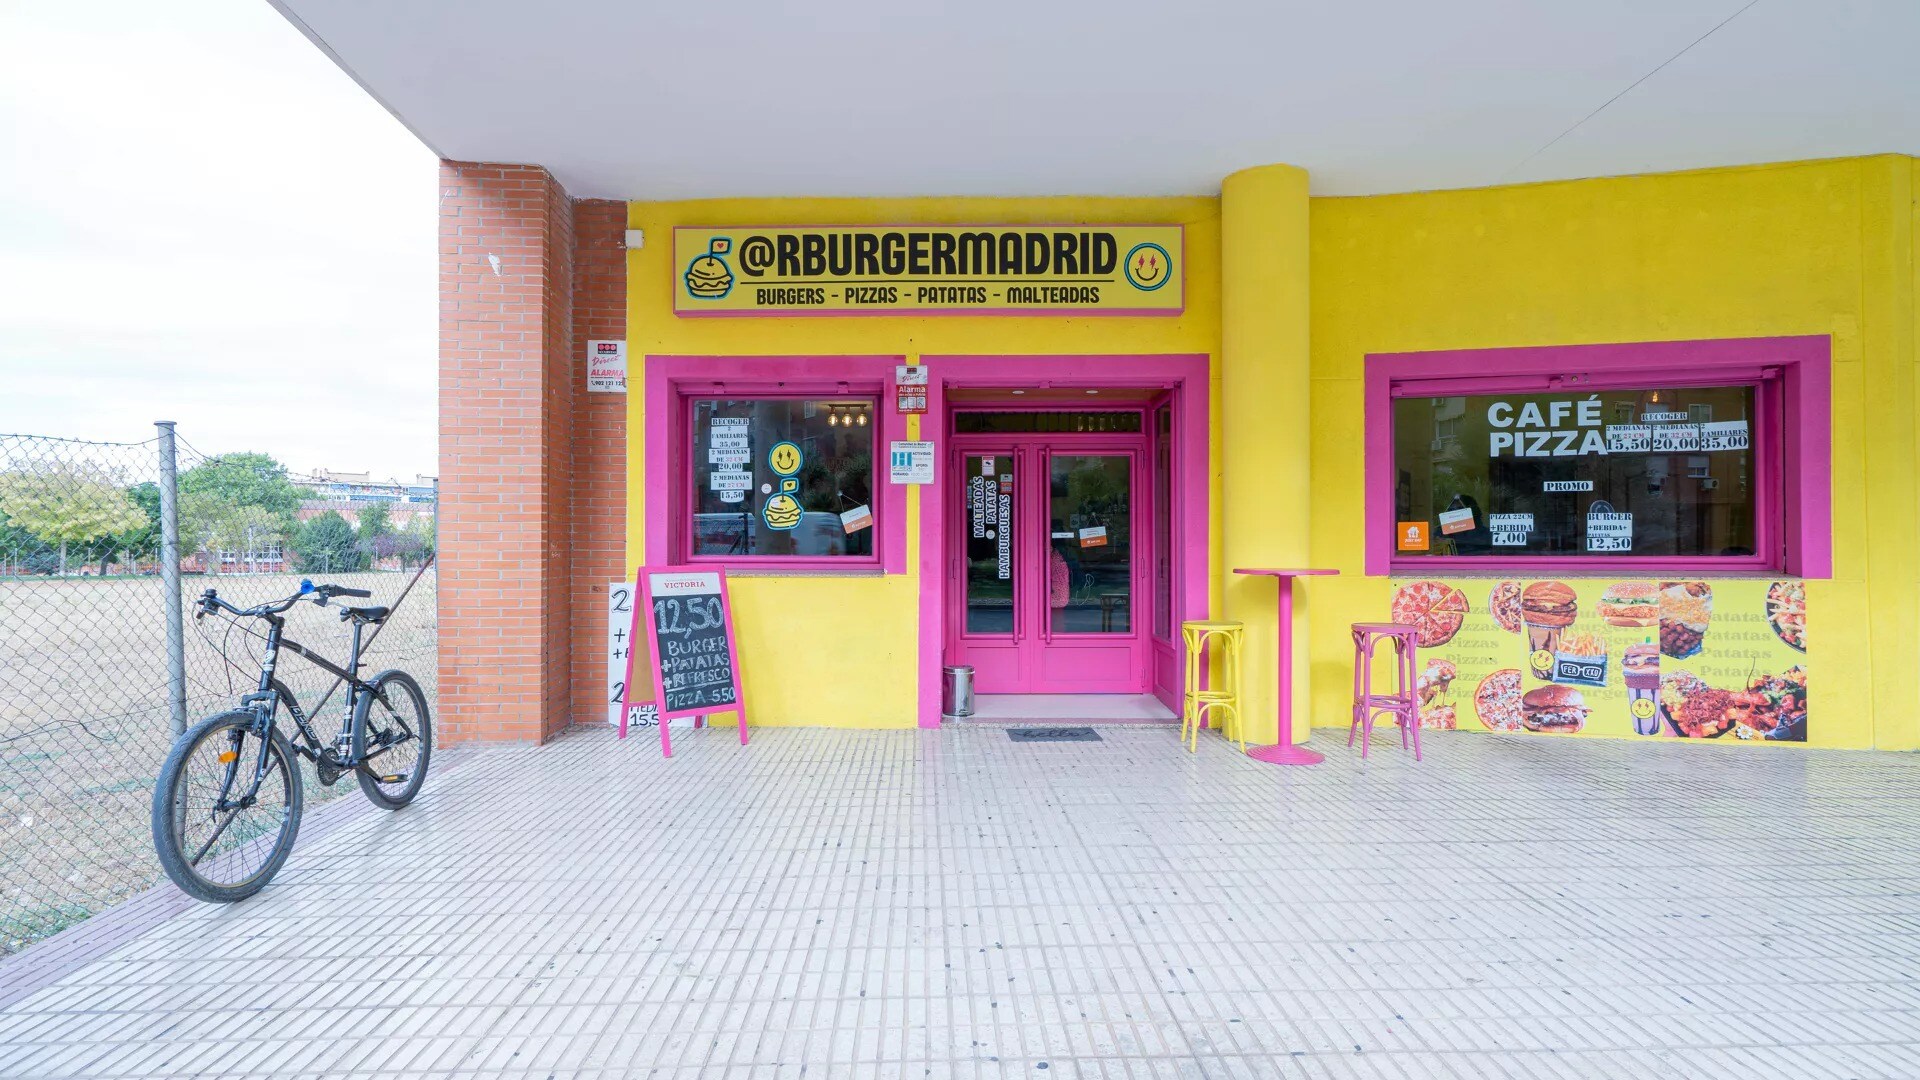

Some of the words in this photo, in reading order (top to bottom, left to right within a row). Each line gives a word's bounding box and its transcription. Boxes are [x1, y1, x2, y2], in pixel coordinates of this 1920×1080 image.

[739, 232, 1118, 276] @RBURGERMADRID
[756, 287, 825, 305] BURGERS
[845, 286, 898, 304] PIZZAS
[917, 286, 987, 304] PATATAS
[1007, 286, 1100, 304] MALTEADAS
[591, 369, 625, 377] ALARMA
[1487, 394, 1602, 429] CAFÉ
[1642, 413, 1687, 421] RECOGER
[712, 418, 749, 426] RECOGER
[1660, 423, 1699, 431] MEDIANAS
[1701, 429, 1748, 437] FAMILIARES
[719, 441, 741, 449] 35,00
[1490, 430, 1609, 458] PIZZA
[1606, 438, 1651, 451] 15,50
[1653, 438, 1699, 451] 20,00
[1701, 436, 1748, 450] 35,00
[718, 463, 743, 471] 20,00
[1546, 482, 1590, 491] PROMO
[721, 491, 744, 500] 15,50
[986, 480, 996, 524] PATATAS
[974, 476, 984, 538] MALTEADAS
[1588, 513, 1632, 521] BURGER
[999, 494, 1010, 579] HAMBURGUESAS
[1493, 532, 1526, 544] 7,00
[1587, 538, 1631, 551] 12,50
[664, 581, 706, 589] VICTORIA
[611, 590, 631, 613] 2
[653, 597, 724, 639] 12,50
[668, 635, 728, 656] BURGER
[1563, 666, 1577, 675] FER
[666, 690, 706, 711] PIZZA
